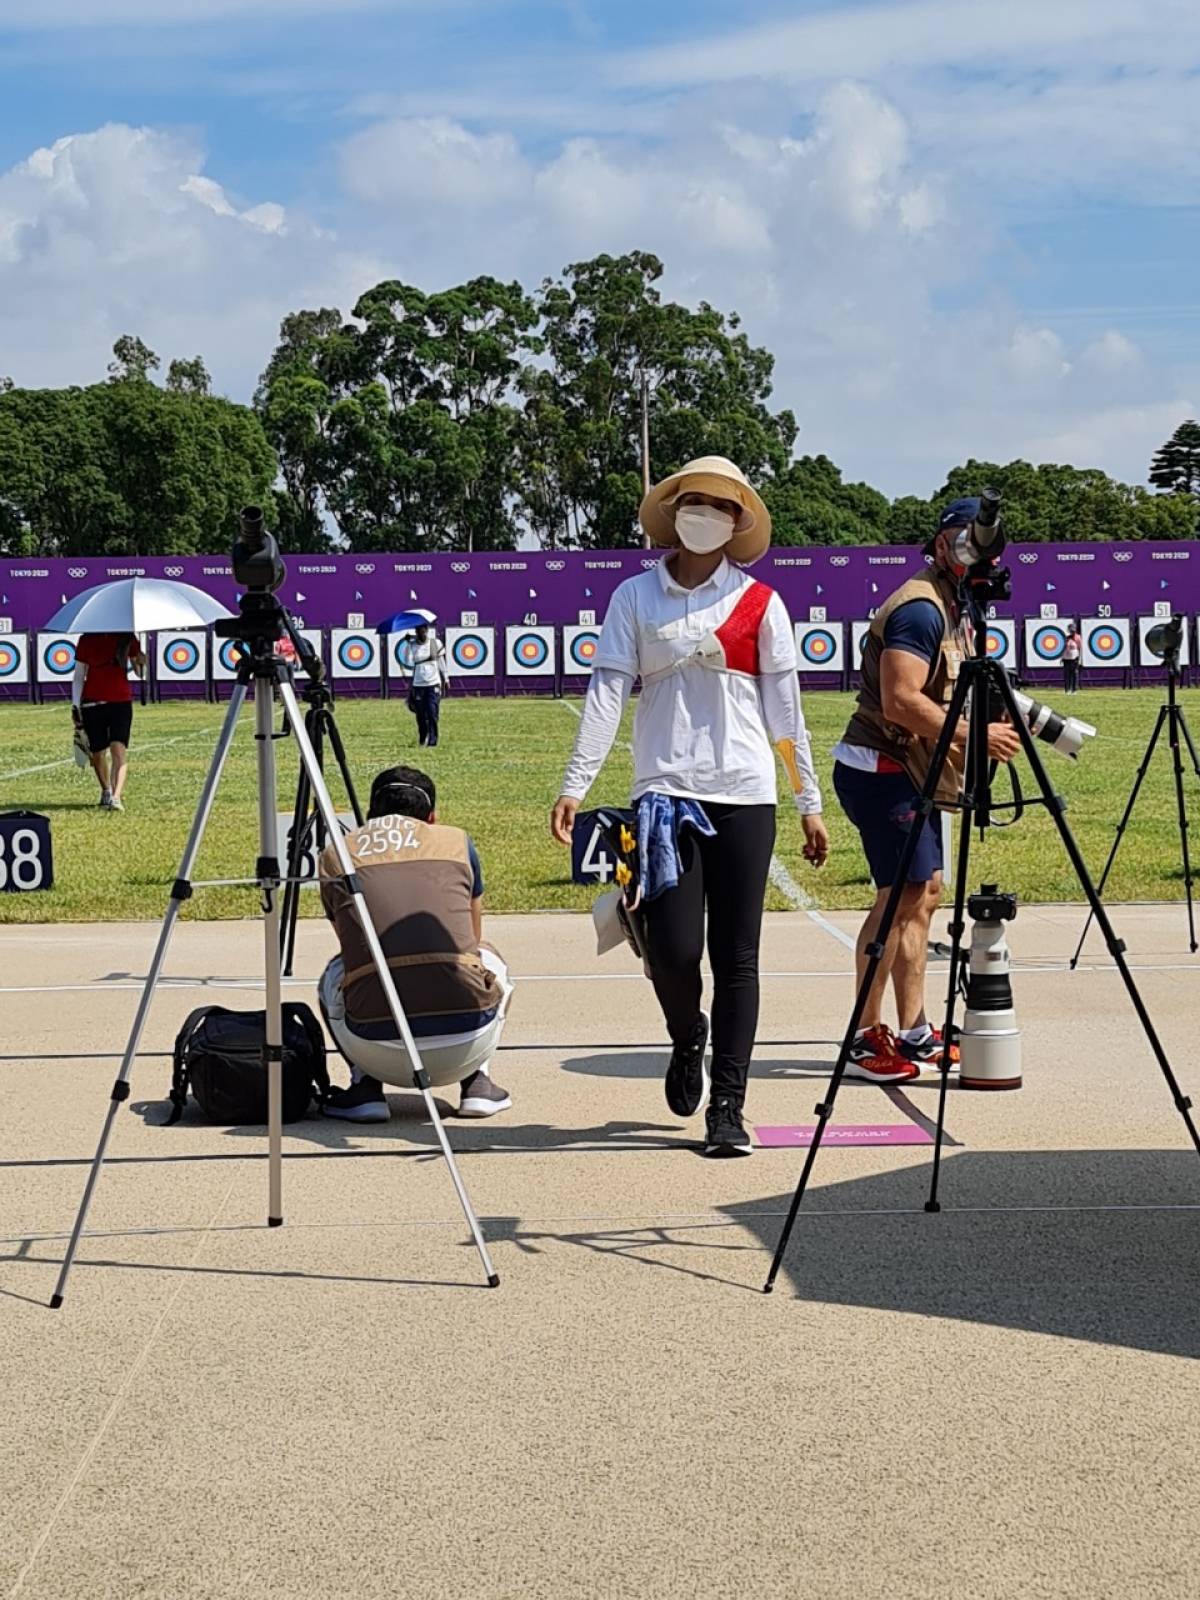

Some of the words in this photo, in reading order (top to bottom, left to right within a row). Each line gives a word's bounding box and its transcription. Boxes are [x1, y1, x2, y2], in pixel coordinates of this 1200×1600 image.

[868, 557, 889, 565] TOKYO
[890, 557, 906, 565] 2020
[1151, 552, 1172, 560] TOKYO
[1173, 552, 1189, 560] 2020
[489, 563, 510, 571] TOKYO
[511, 563, 527, 571] 2020
[584, 561, 605, 569] TOKYO
[606, 561, 622, 569] 2020
[774, 558, 795, 566] TOKYO
[795, 558, 811, 566] 2020
[106, 568, 128, 576] TOKYO
[129, 568, 145, 576] 2020
[203, 567, 224, 575] TOKYO
[299, 565, 320, 573] TOKYO
[320, 565, 336, 573] 2020
[394, 564, 415, 572] TOKYO
[416, 564, 432, 572] 2020
[811, 609, 824, 620] 45
[1043, 607, 1055, 618] 49
[1098, 604, 1111, 617] 50
[1156, 604, 1168, 616] 51
[349, 615, 361, 627] 37
[463, 614, 476, 626] 39
[523, 613, 537, 626] 40
[581, 613, 593, 624] 41
[357, 829, 420, 856] 2594
[0, 829, 43, 890] 8
